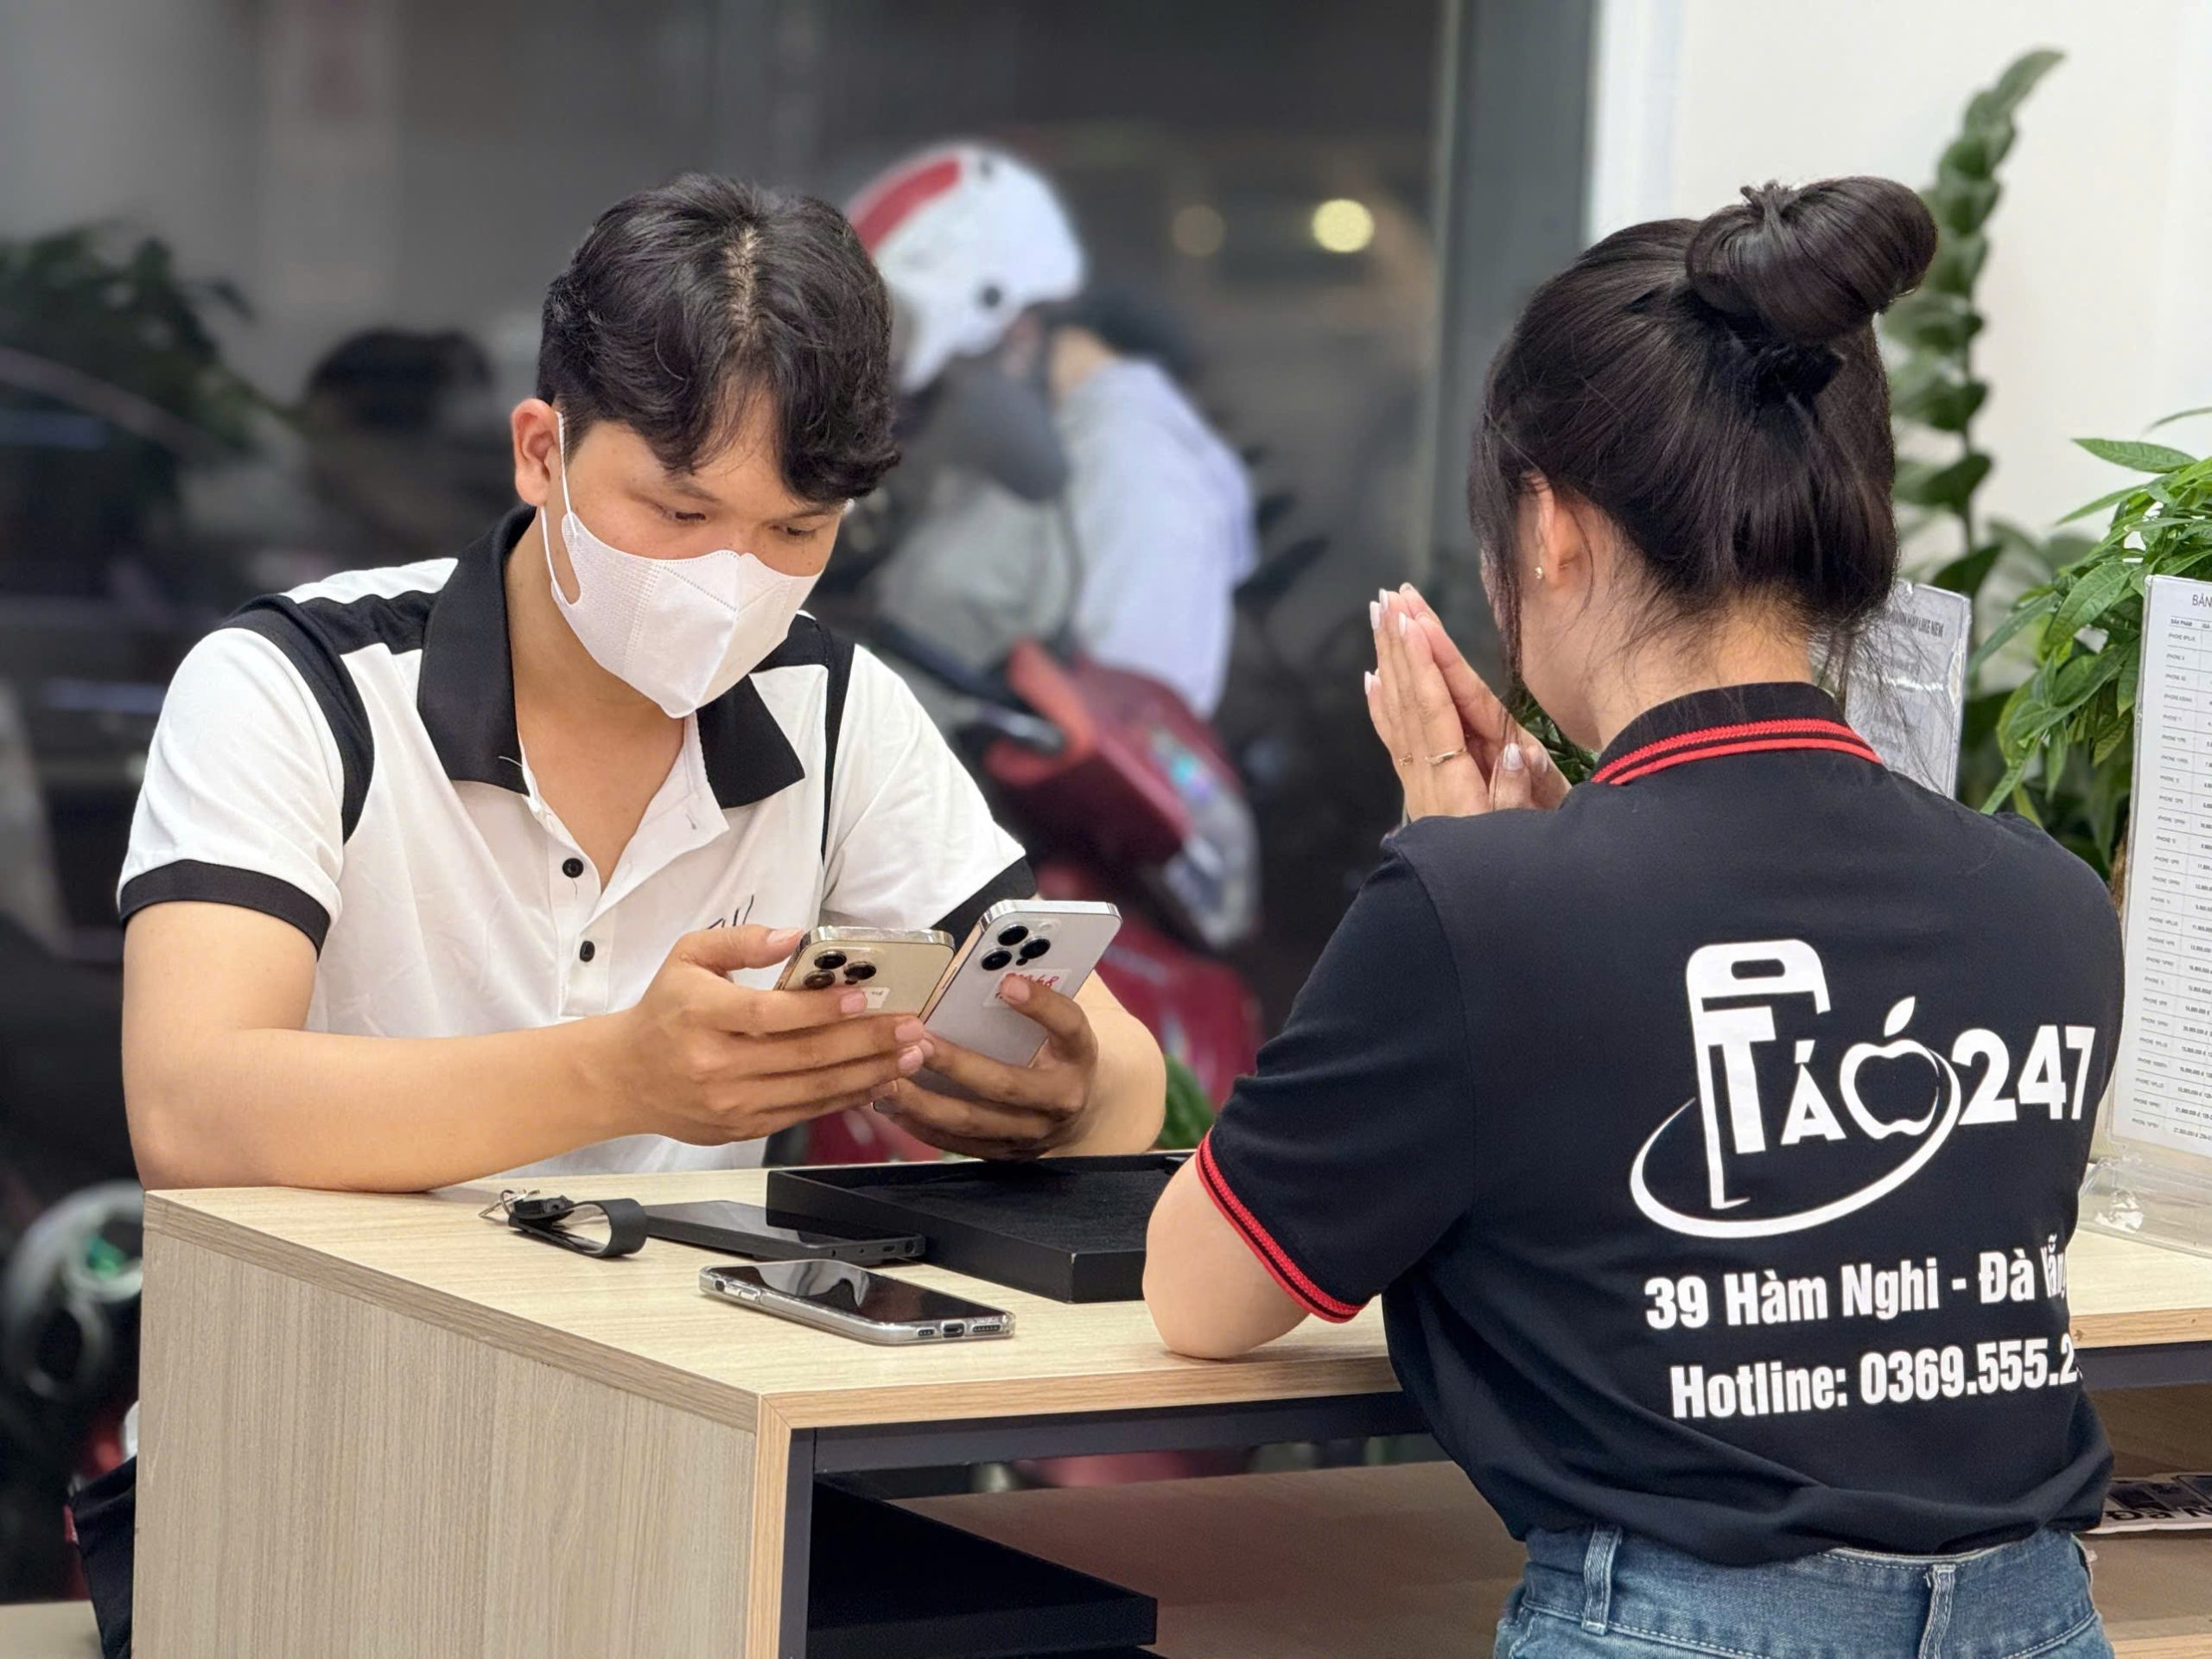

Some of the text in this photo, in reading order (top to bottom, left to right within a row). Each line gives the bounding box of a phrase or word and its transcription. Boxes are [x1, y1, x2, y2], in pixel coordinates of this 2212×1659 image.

[1644, 1274, 1709, 1330] 39
[1723, 1268, 1828, 1326] Hàm
[1840, 1258, 1940, 1321] Nghi
[1978, 1248, 2036, 1304] Đà
[1669, 1332, 2083, 1419] Hotline: 0369.555.2
